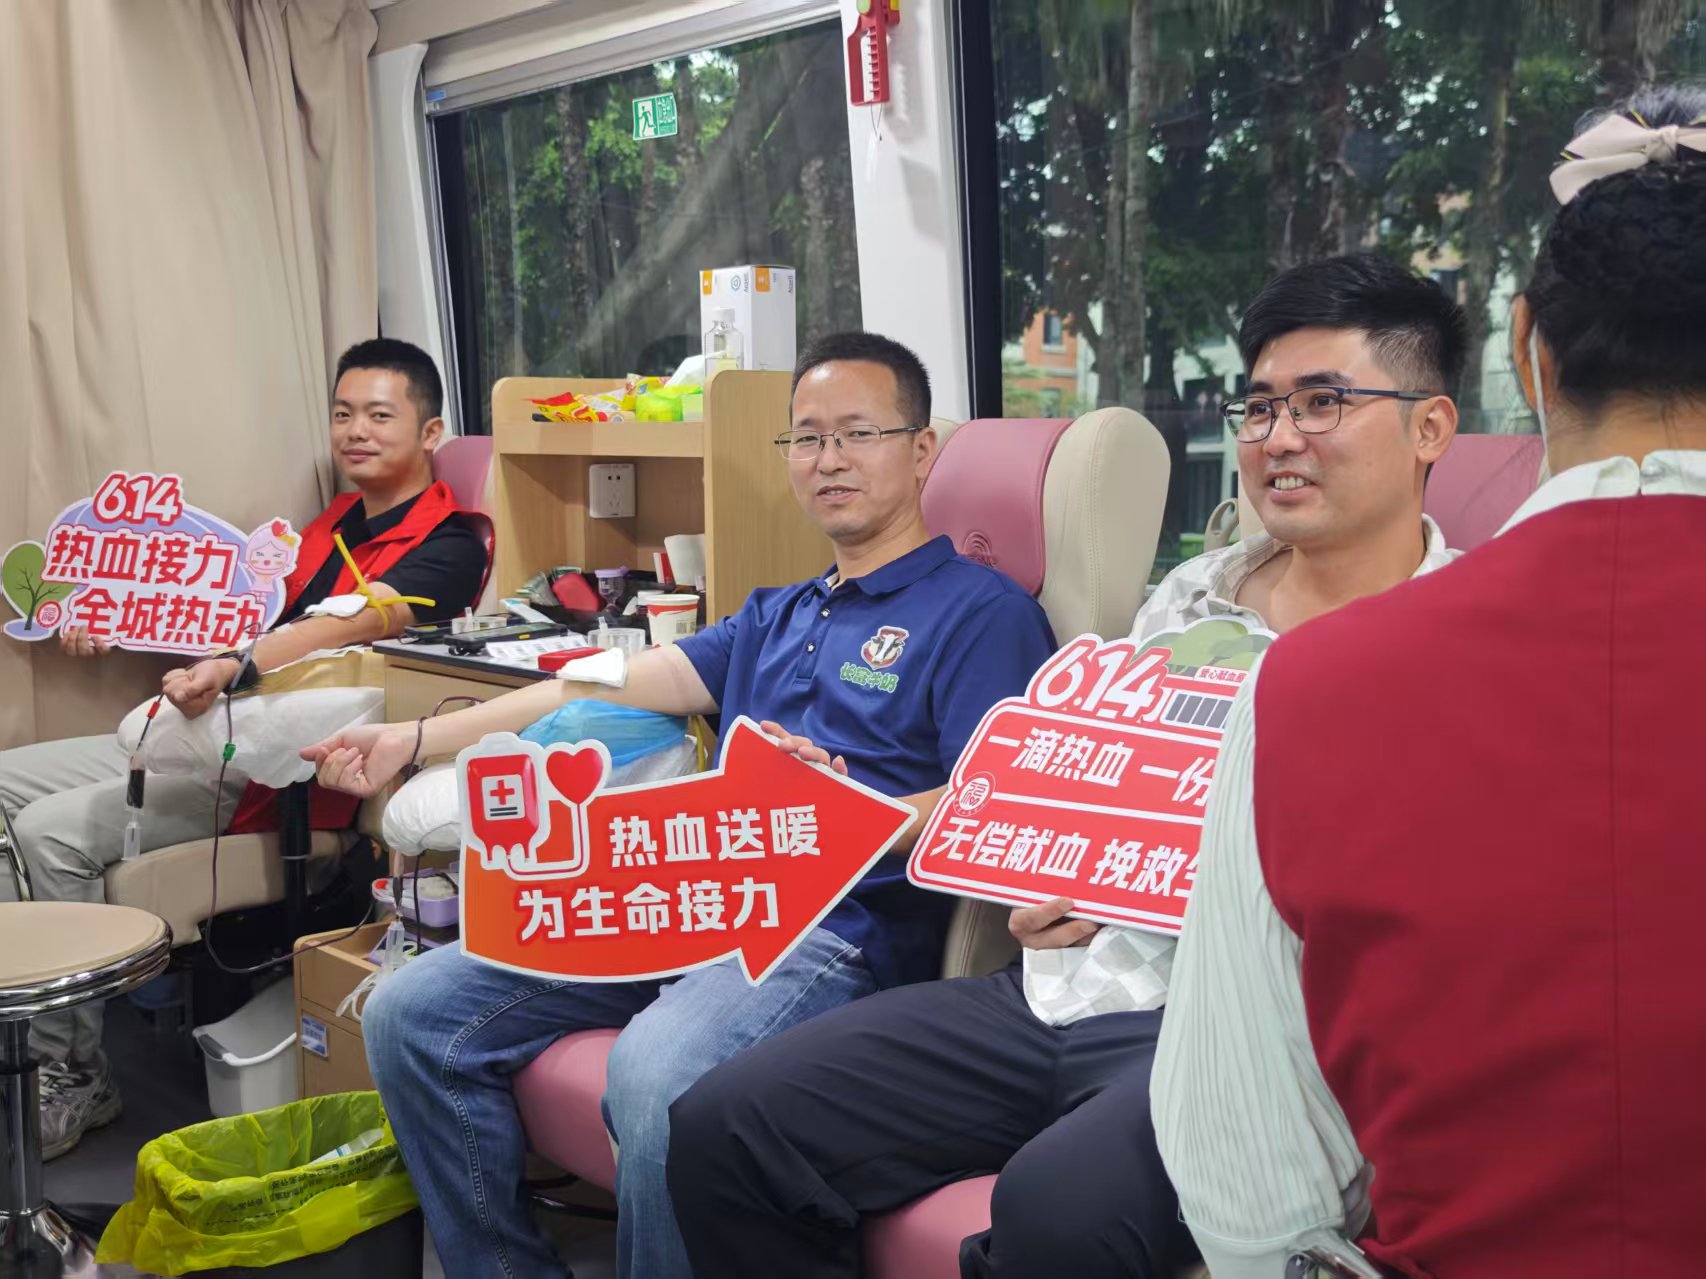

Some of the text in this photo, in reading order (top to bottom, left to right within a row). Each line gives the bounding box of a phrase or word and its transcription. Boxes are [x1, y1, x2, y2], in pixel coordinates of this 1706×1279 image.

[96, 474, 179, 523] 6.14
[50, 530, 234, 589] 热血接力
[71, 588, 261, 647] 全城热动
[1035, 644, 1165, 721] 6.14
[988, 727, 1134, 788] 一滴热血
[609, 804, 821, 868] 热血送暖
[930, 817, 1090, 878] 无偿献血
[518, 877, 780, 941] 为生命接力
